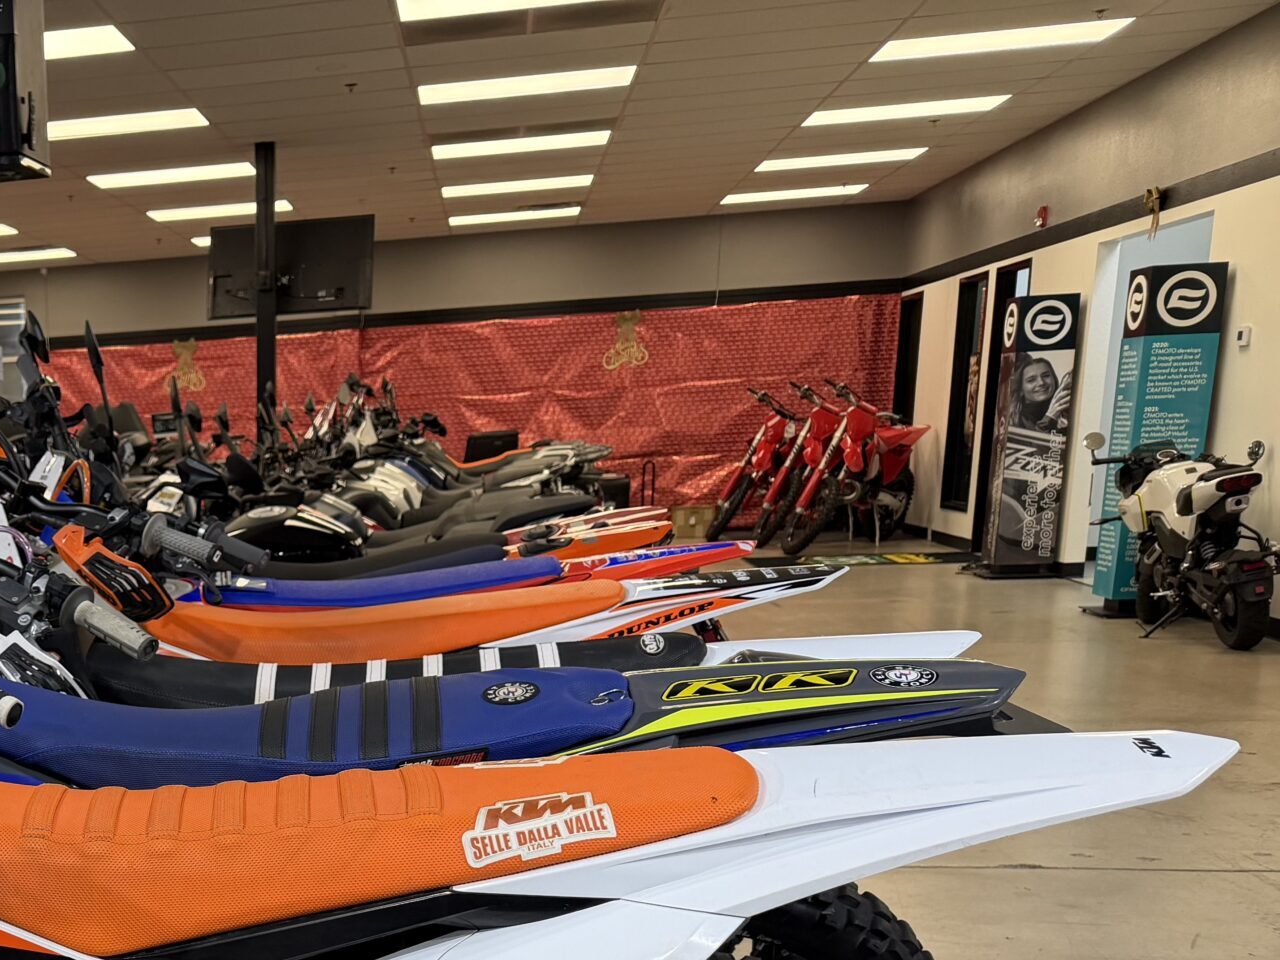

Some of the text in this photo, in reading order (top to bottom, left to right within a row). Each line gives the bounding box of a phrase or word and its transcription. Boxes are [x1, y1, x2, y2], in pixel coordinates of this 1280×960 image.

[1021, 455, 1041, 551] experien
[1038, 510, 1055, 557] more
[608, 602, 714, 638] DUNLOP
[483, 795, 587, 831] KTM
[470, 807, 608, 862] SELLE DALLA VALLE
[527, 840, 556, 852] ITALY
